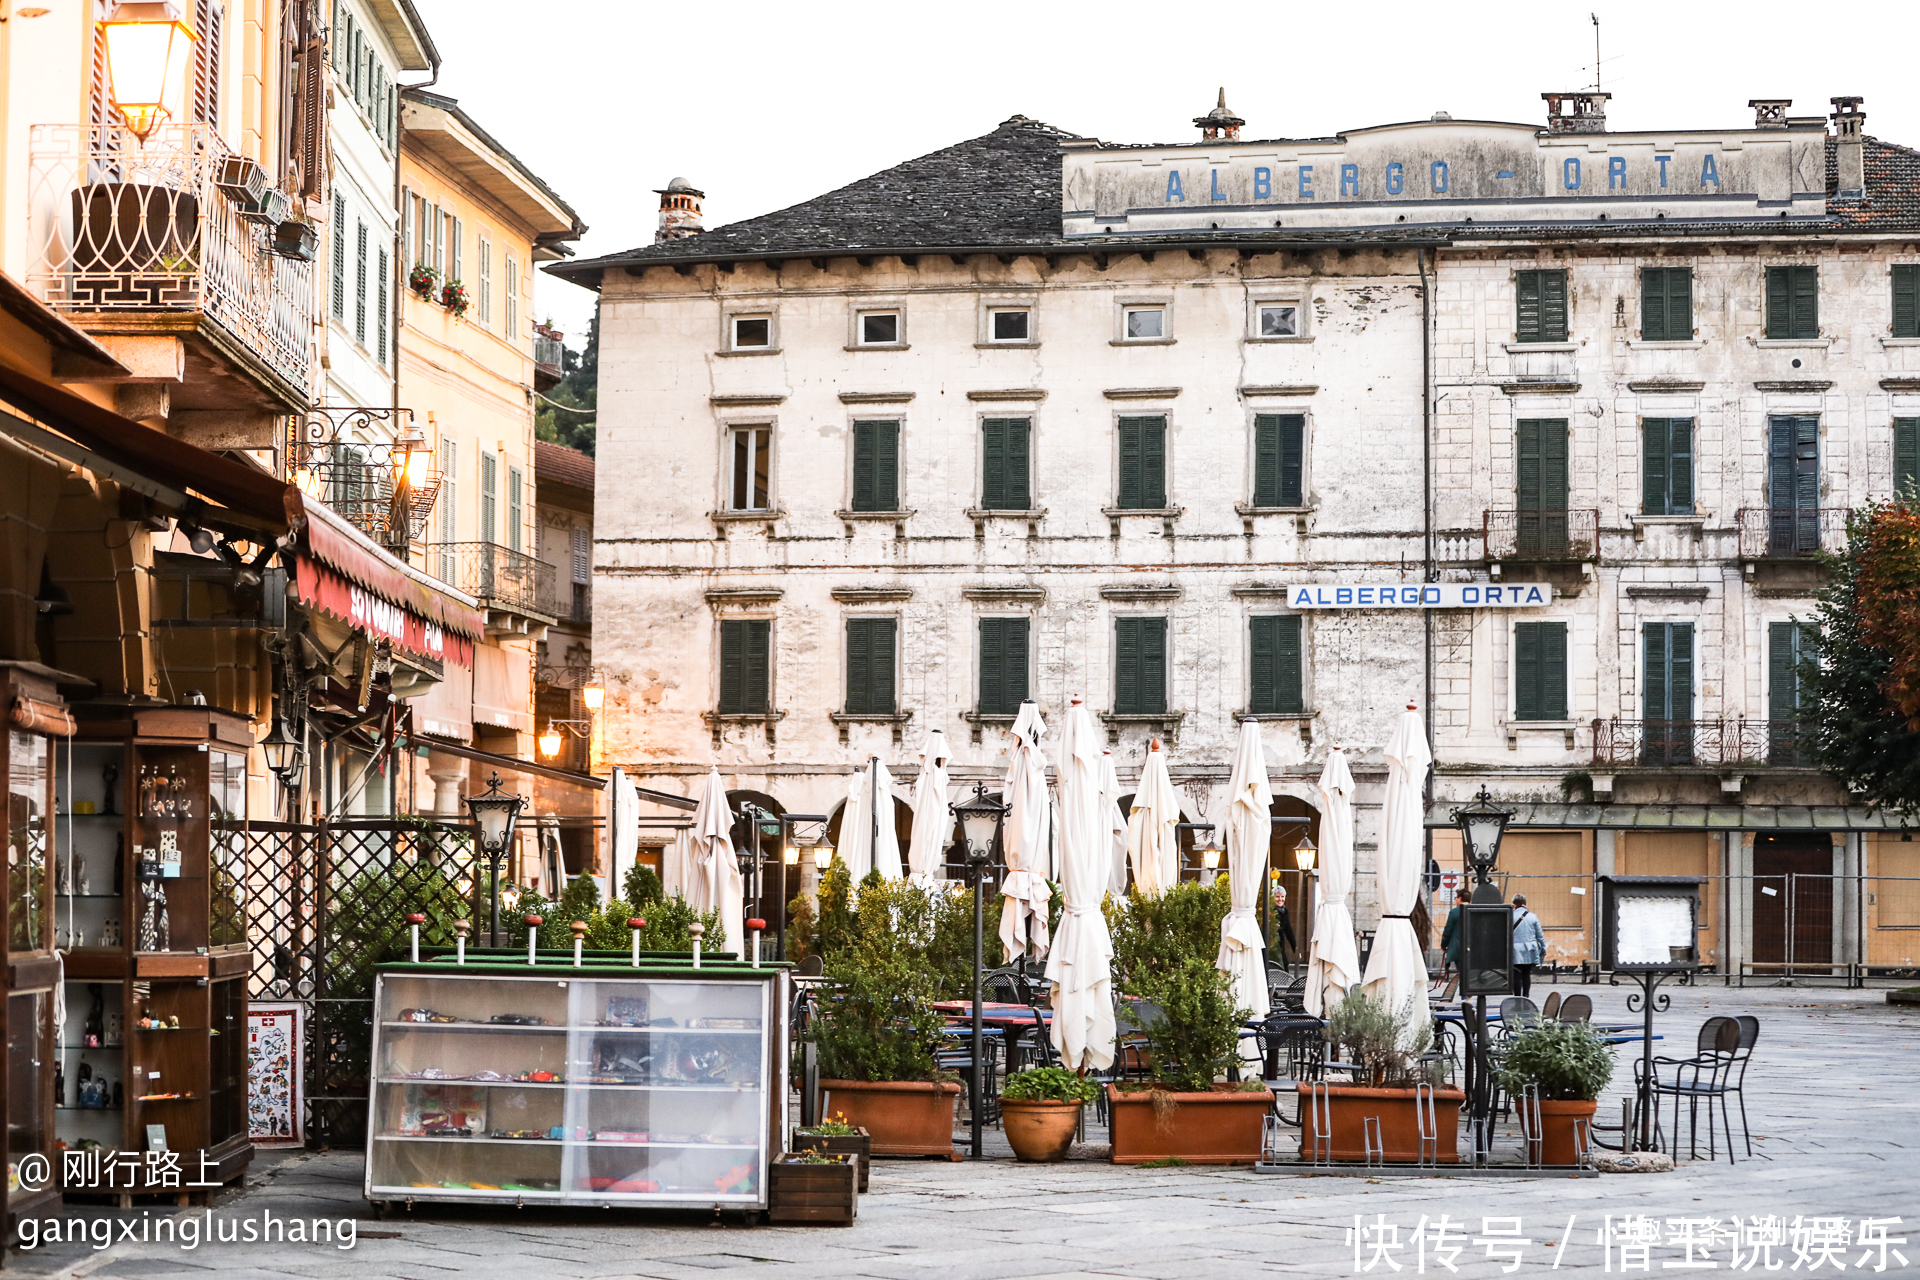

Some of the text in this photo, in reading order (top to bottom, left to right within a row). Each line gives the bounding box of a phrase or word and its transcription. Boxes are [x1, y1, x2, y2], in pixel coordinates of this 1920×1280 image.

[1166, 161, 1449, 202] ALBERGO
[1563, 154, 1719, 190] ORTA
[1295, 586, 1544, 604] ALBERGO ORTA
